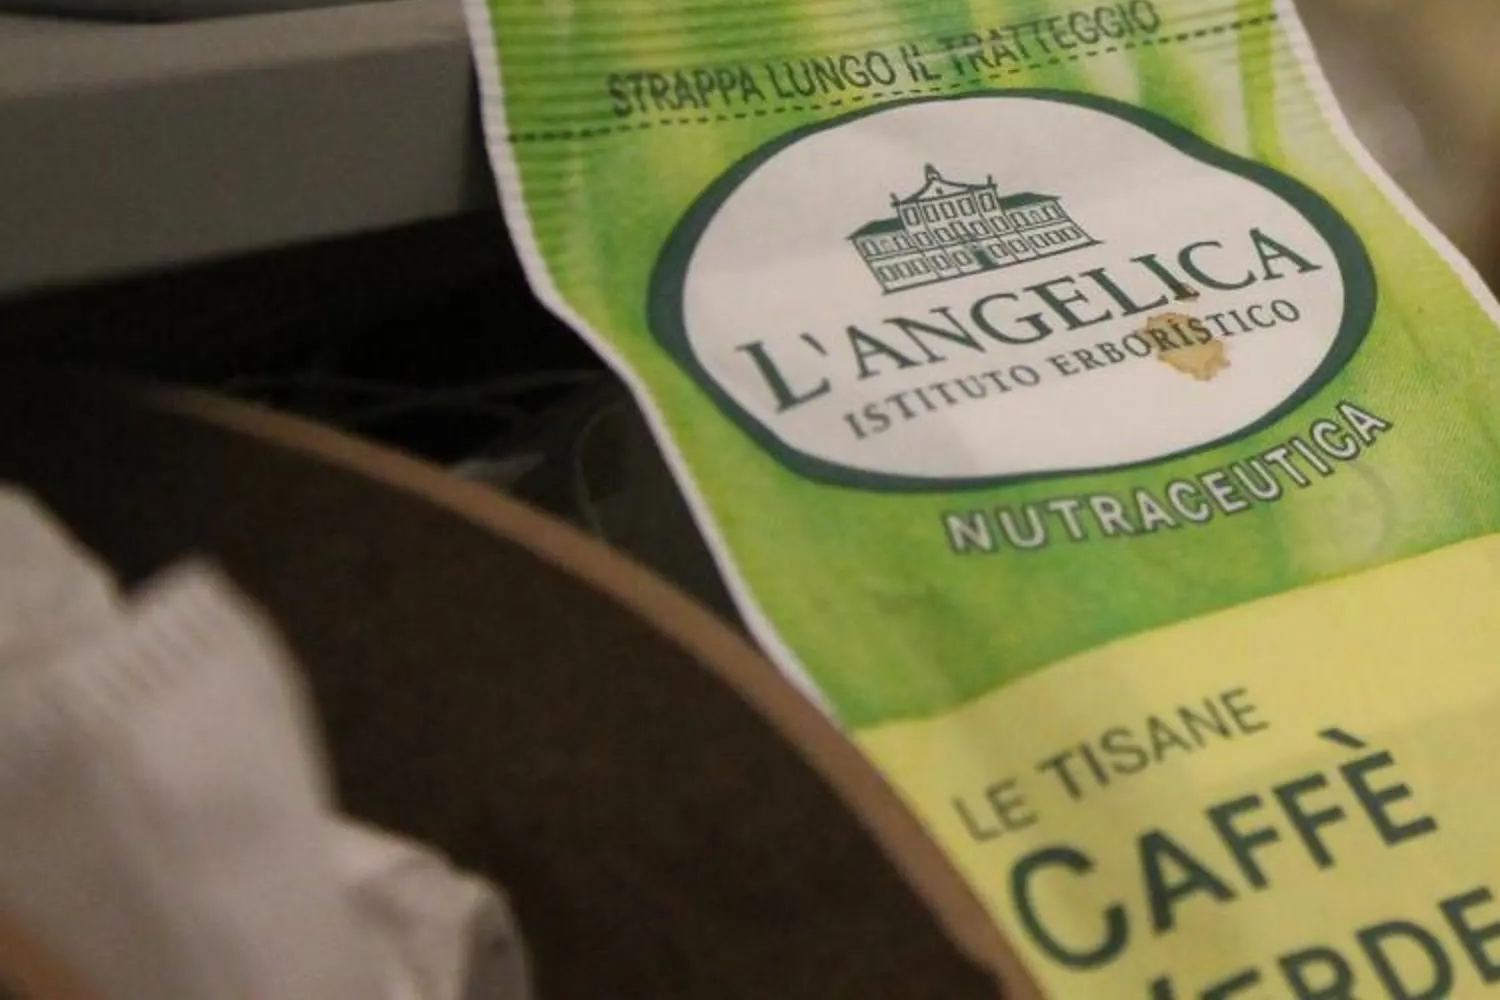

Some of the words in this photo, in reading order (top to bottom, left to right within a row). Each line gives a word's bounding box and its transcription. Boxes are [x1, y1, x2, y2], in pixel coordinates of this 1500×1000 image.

[608, 68, 764, 118] STRAPPA
[770, 49, 896, 99] LUNGO
[903, 45, 941, 82] IL
[735, 227, 1322, 414] L'ANGELICA
[844, 364, 1042, 439] ISTITUTO
[1050, 298, 1301, 378] ERBORISTICO
[943, 399, 1392, 554] NUTRACEUTICA
[953, 779, 1039, 842] LE
[1036, 688, 1269, 803] TISANE
[1010, 727, 1439, 972] CAFFÈ
